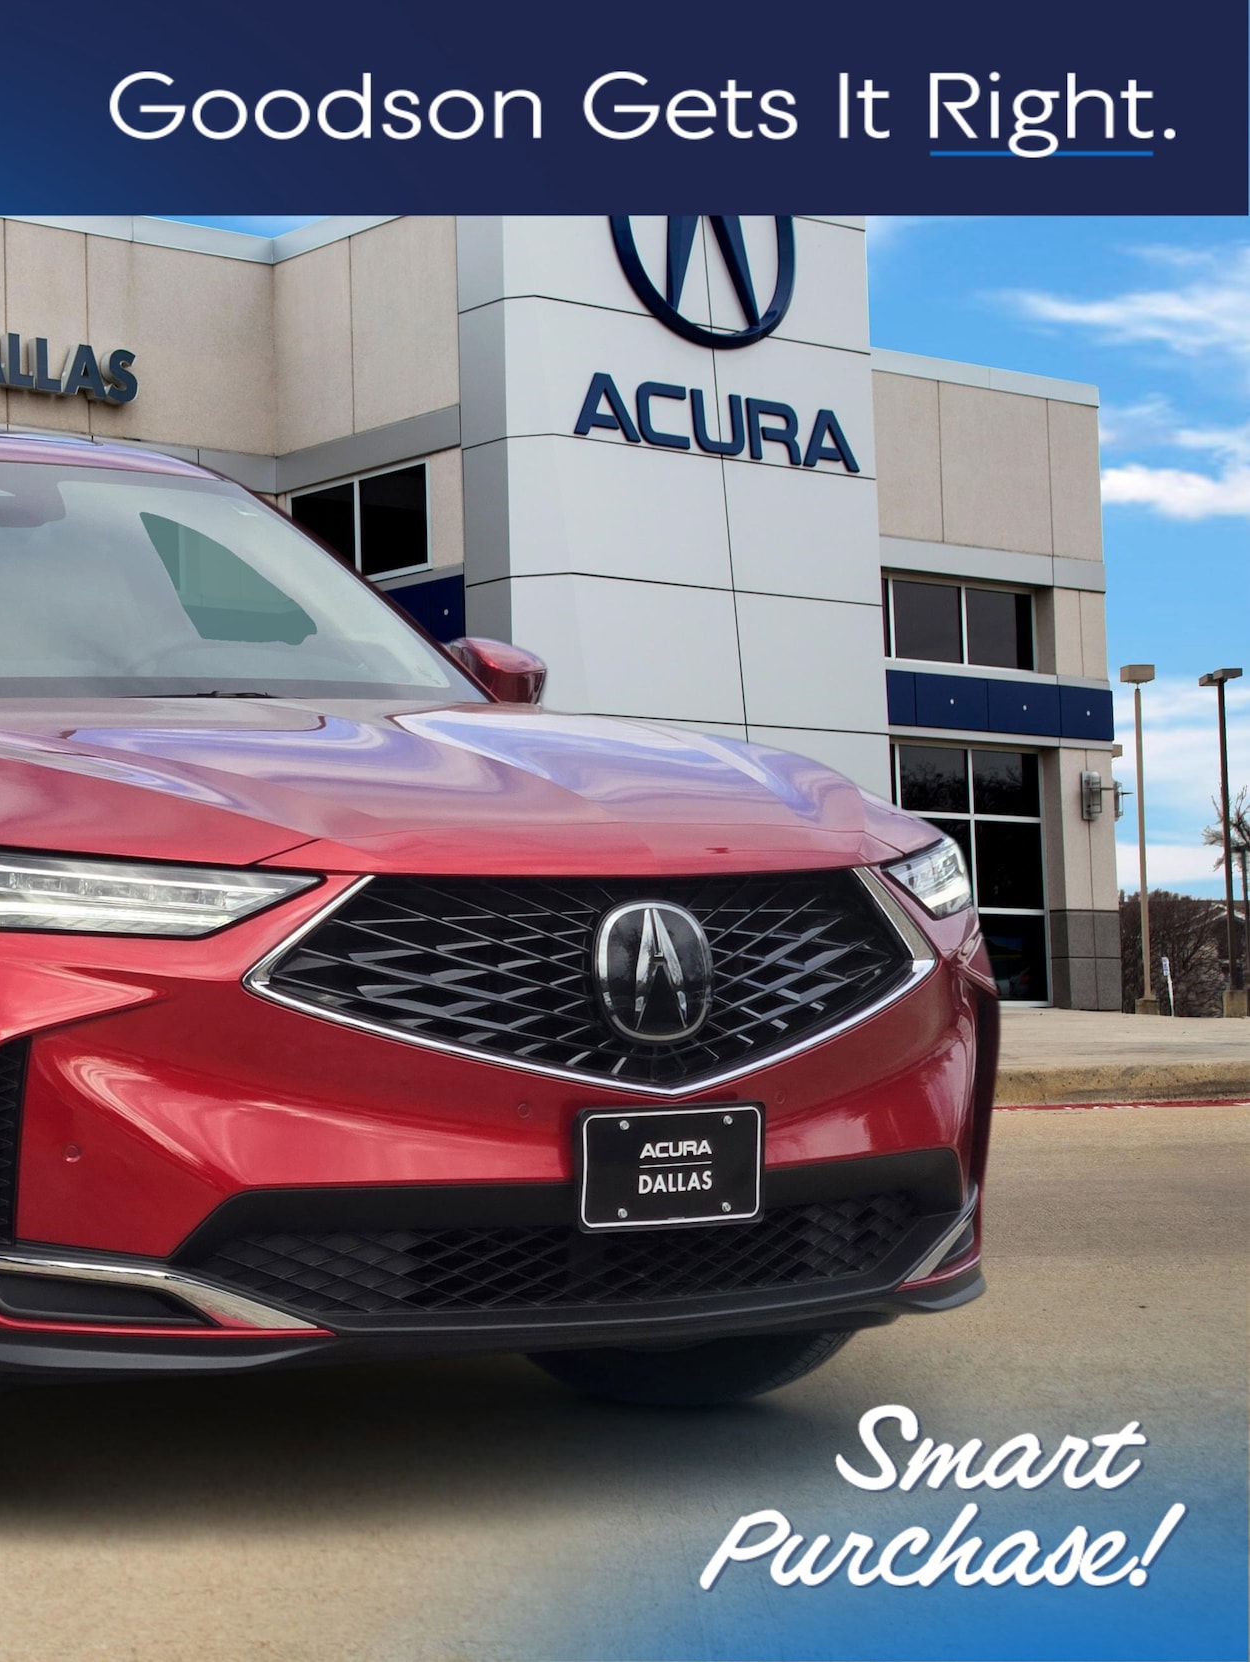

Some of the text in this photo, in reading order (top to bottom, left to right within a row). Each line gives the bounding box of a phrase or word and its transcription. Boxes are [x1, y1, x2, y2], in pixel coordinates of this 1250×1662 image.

[573, 371, 861, 473] ACURA
[639, 1139, 713, 1159] ACURA
[638, 1170, 713, 1195] DALLAS
